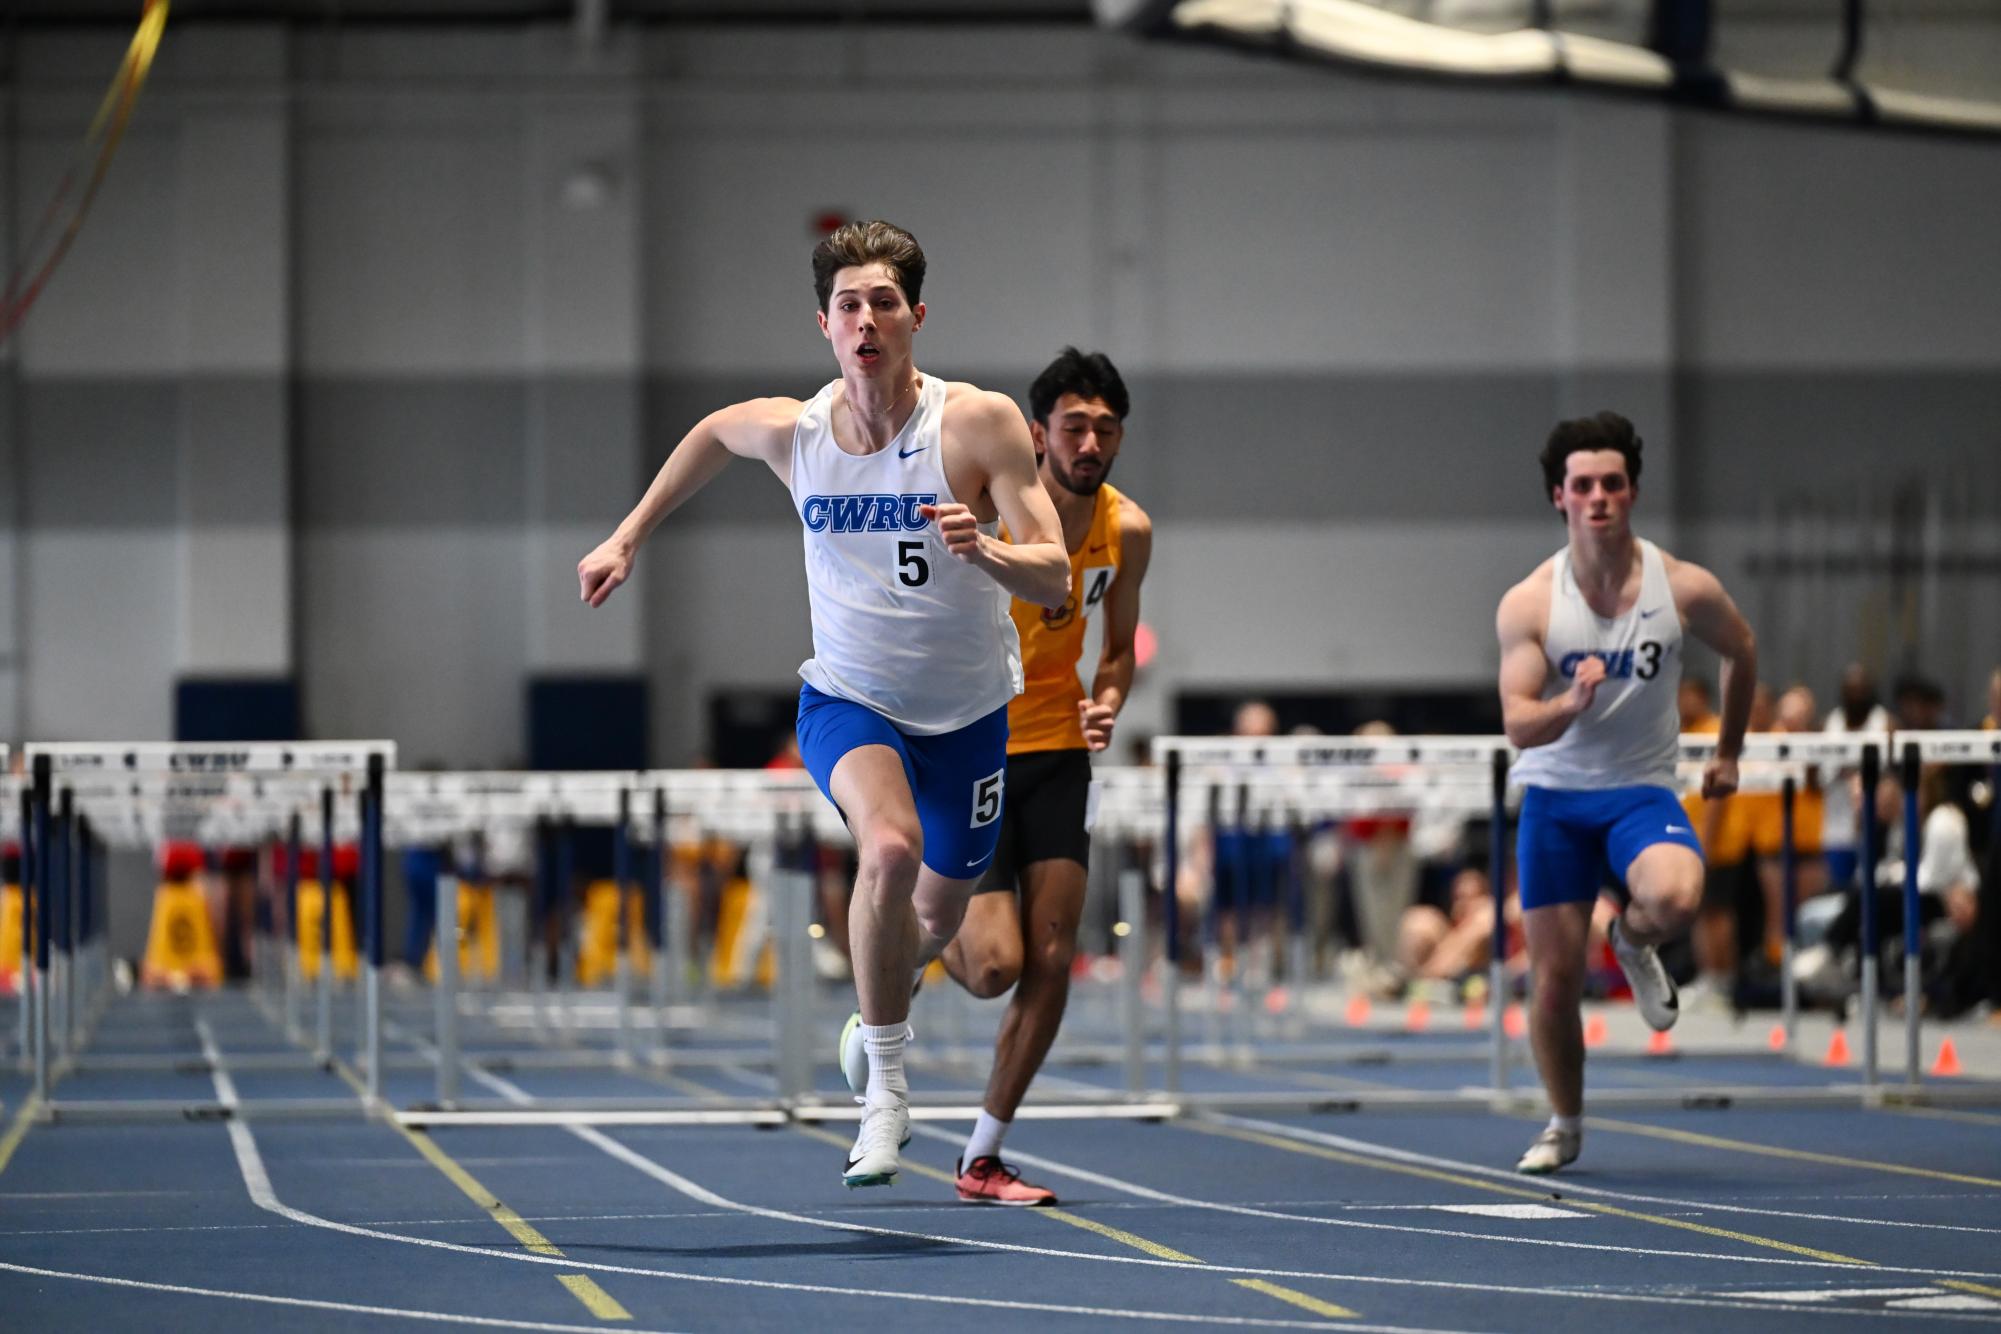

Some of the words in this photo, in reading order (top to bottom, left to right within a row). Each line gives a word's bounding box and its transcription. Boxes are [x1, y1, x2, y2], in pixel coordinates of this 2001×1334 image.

[802, 493, 937, 534] CWRU
[898, 541, 929, 587] 5
[1085, 570, 1109, 607] 4
[1635, 640, 1663, 681] 3
[976, 775, 1000, 824] 5
